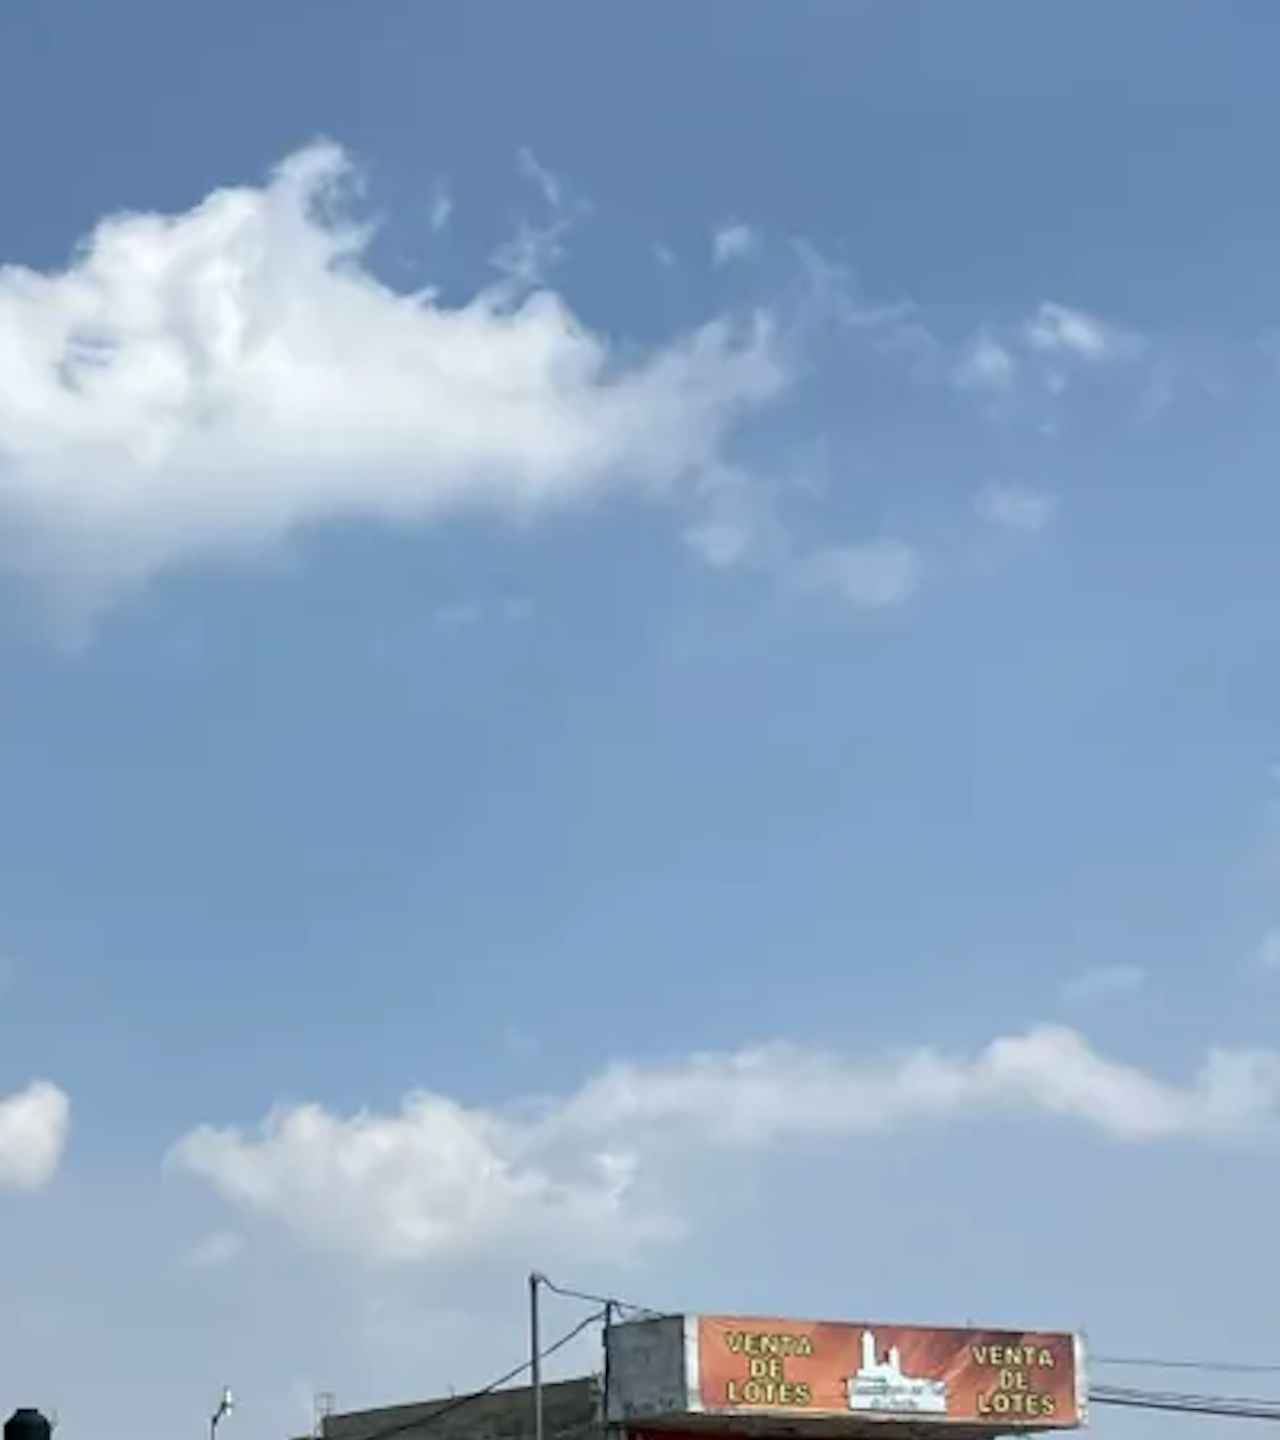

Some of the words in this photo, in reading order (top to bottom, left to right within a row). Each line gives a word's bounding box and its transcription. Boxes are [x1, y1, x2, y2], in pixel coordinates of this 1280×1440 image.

[724, 1331, 814, 1356] VENTA
[971, 1345, 1054, 1368] VENTA
[749, 1357, 783, 1381] DE
[999, 1369, 1030, 1390] DE
[726, 1382, 812, 1405] LOTES
[977, 1395, 1057, 1416] LOTES
